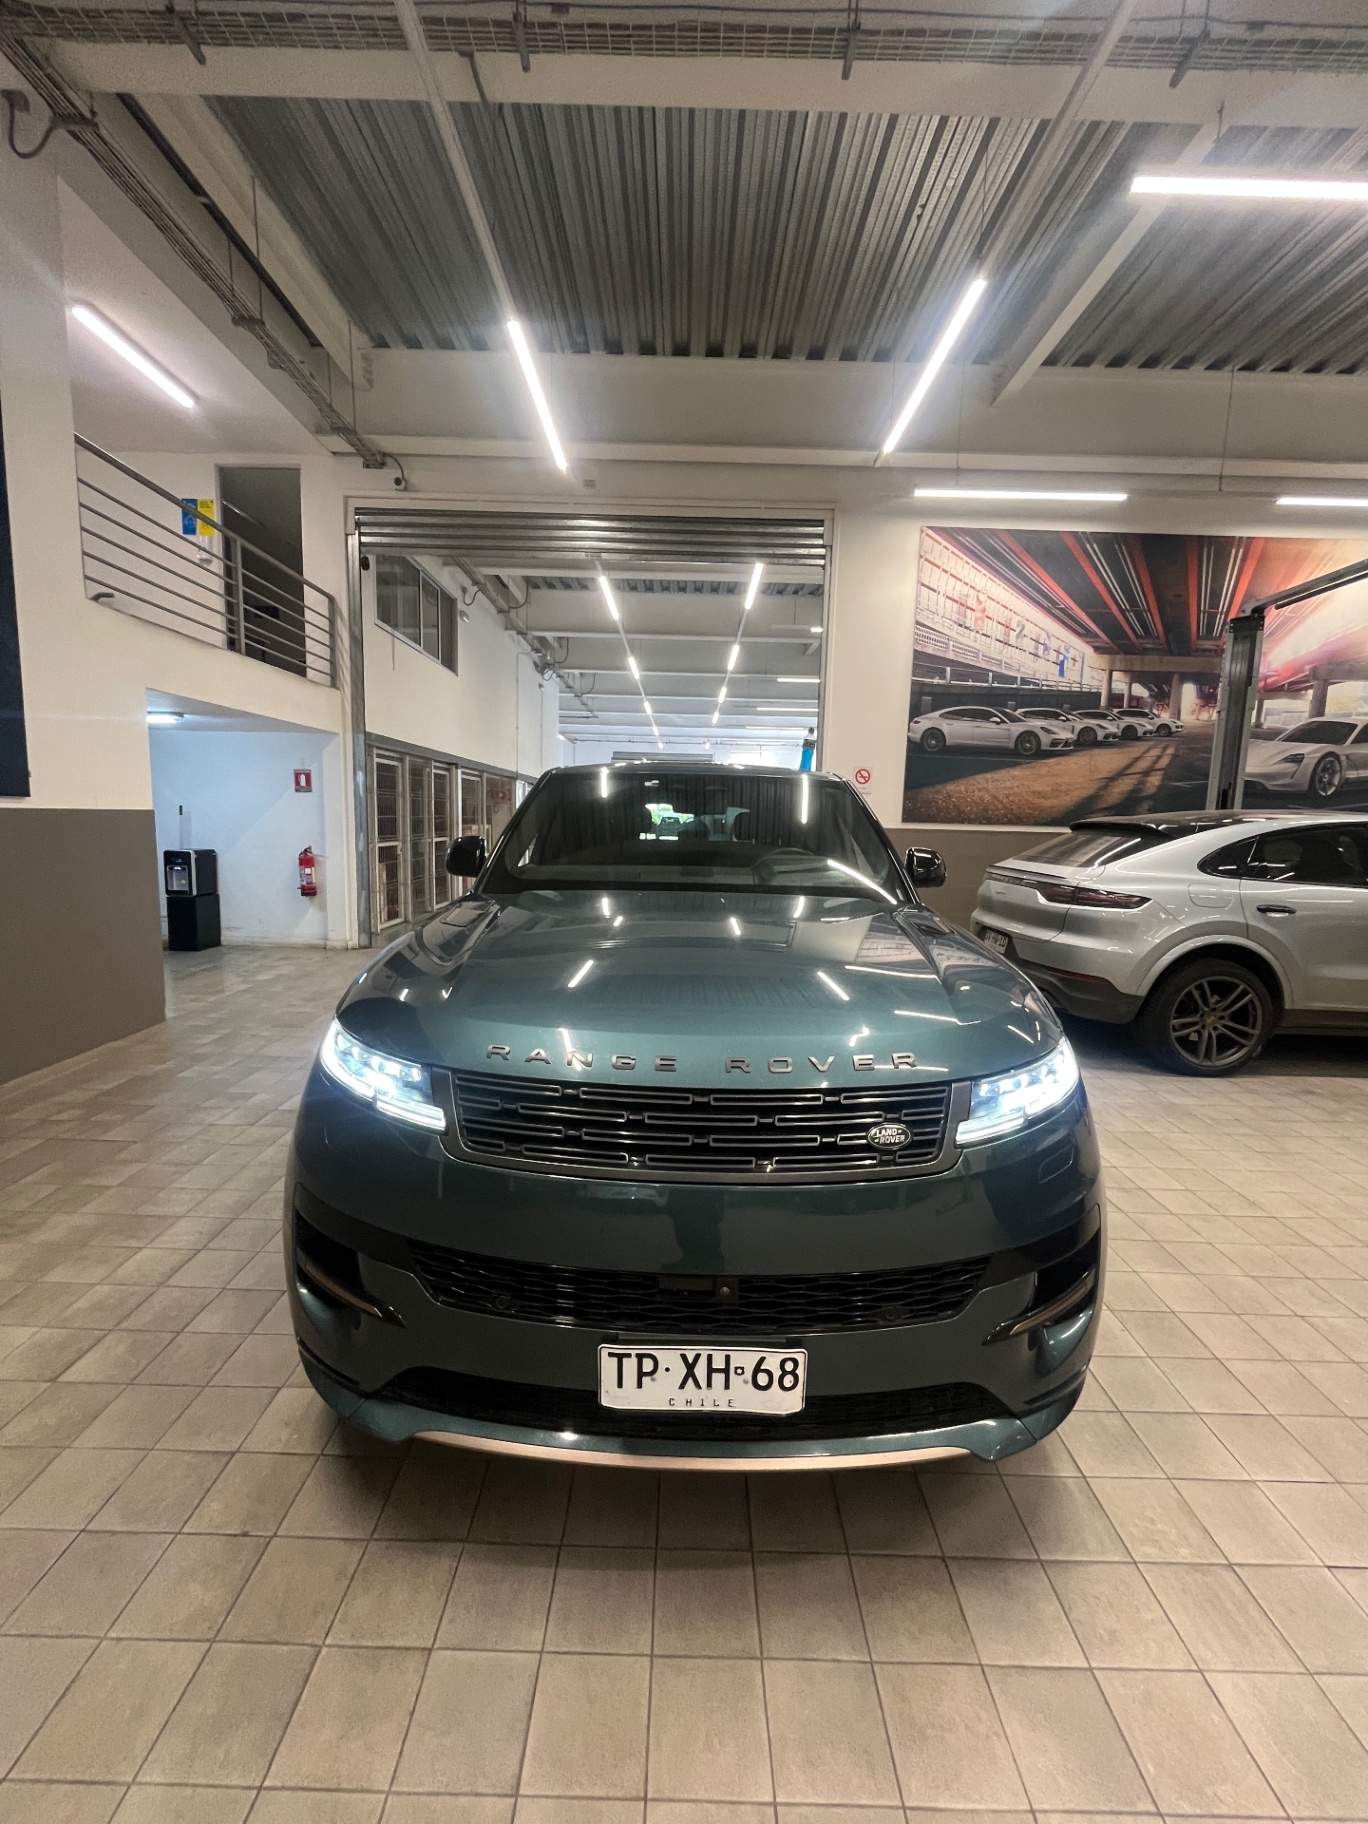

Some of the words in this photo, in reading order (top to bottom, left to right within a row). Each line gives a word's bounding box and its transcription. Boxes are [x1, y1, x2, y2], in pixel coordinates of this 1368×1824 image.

[486, 1044, 677, 1072] RANGE
[725, 1053, 921, 1073] ROVER
[874, 1128, 898, 1137] LAND
[879, 1134, 905, 1144] ROVER
[668, 1398, 736, 1407] CHILE
